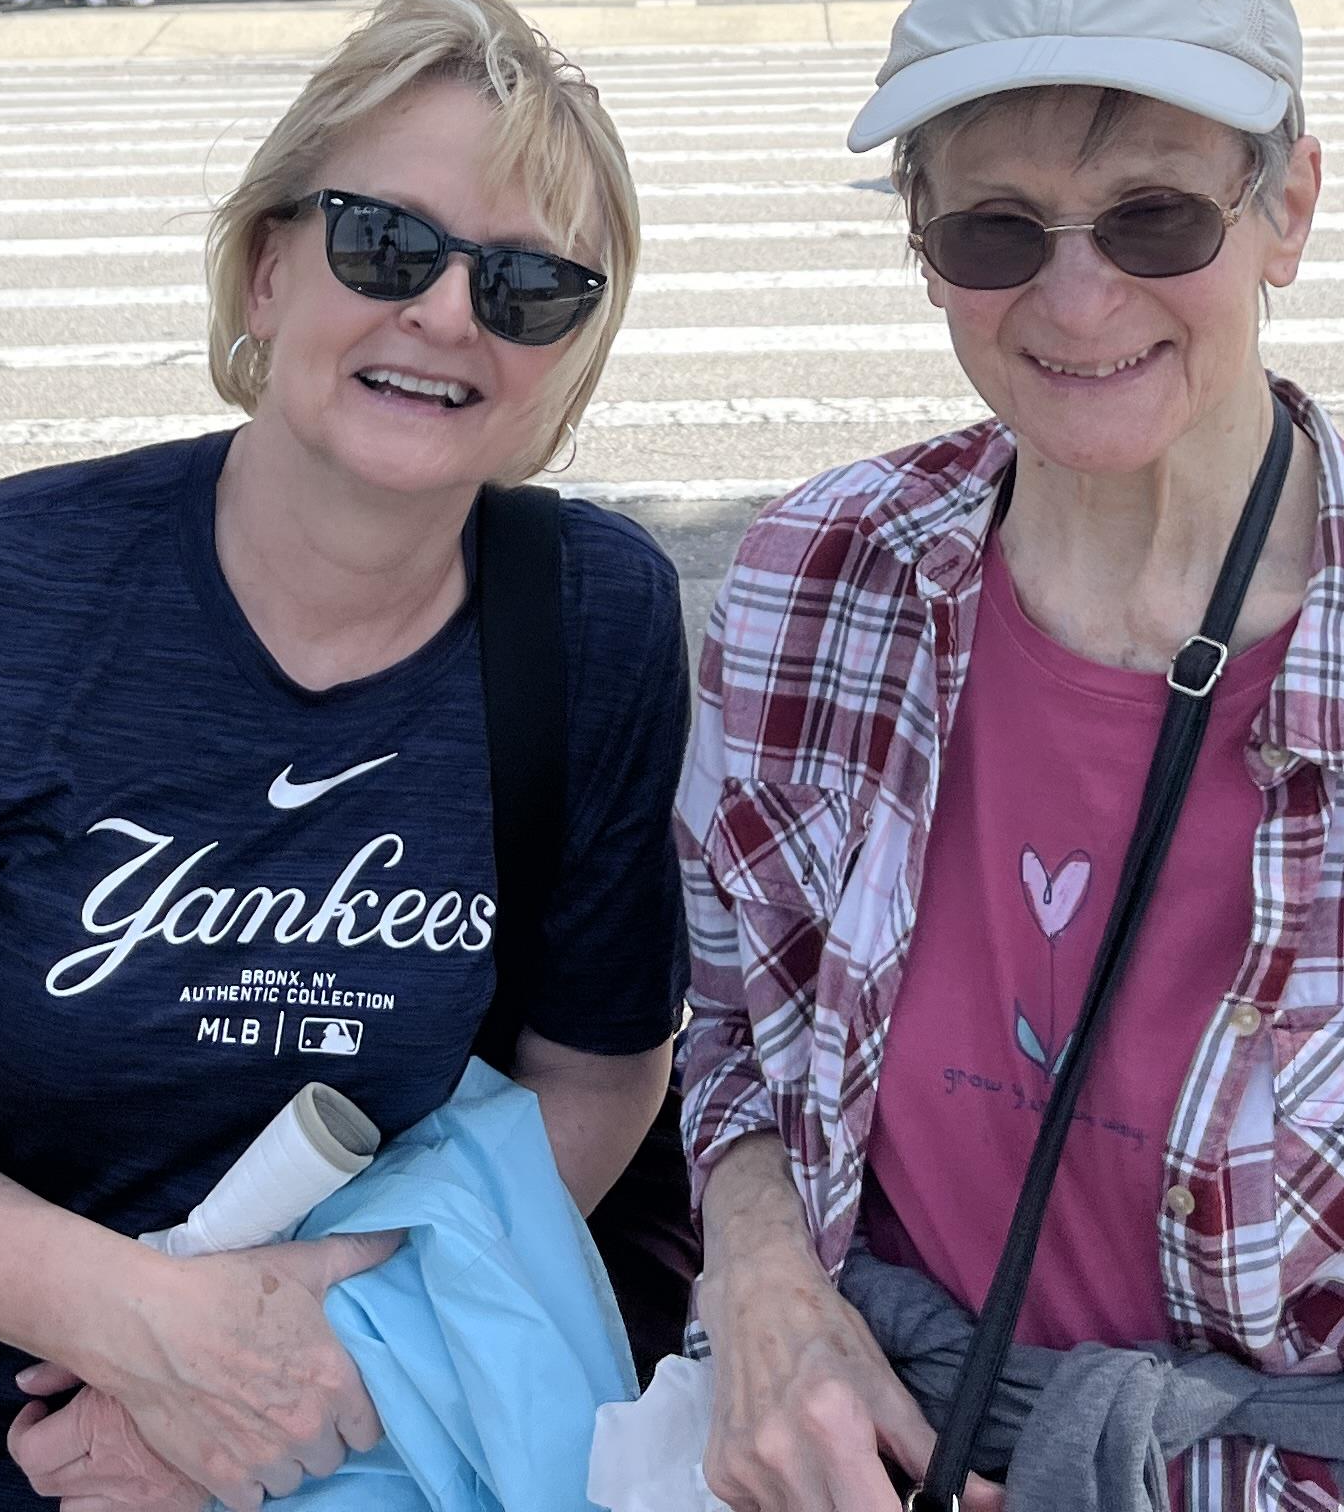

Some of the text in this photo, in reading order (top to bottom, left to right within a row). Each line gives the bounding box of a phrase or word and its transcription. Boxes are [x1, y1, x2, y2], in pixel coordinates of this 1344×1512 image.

[46, 817, 497, 997] Yankees
[241, 969, 337, 989] BRONX, NY
[179, 985, 395, 1010] AUTHENTIC COLLECTION
[197, 1017, 261, 1045] MLB
[943, 1068, 1003, 1095] grow
